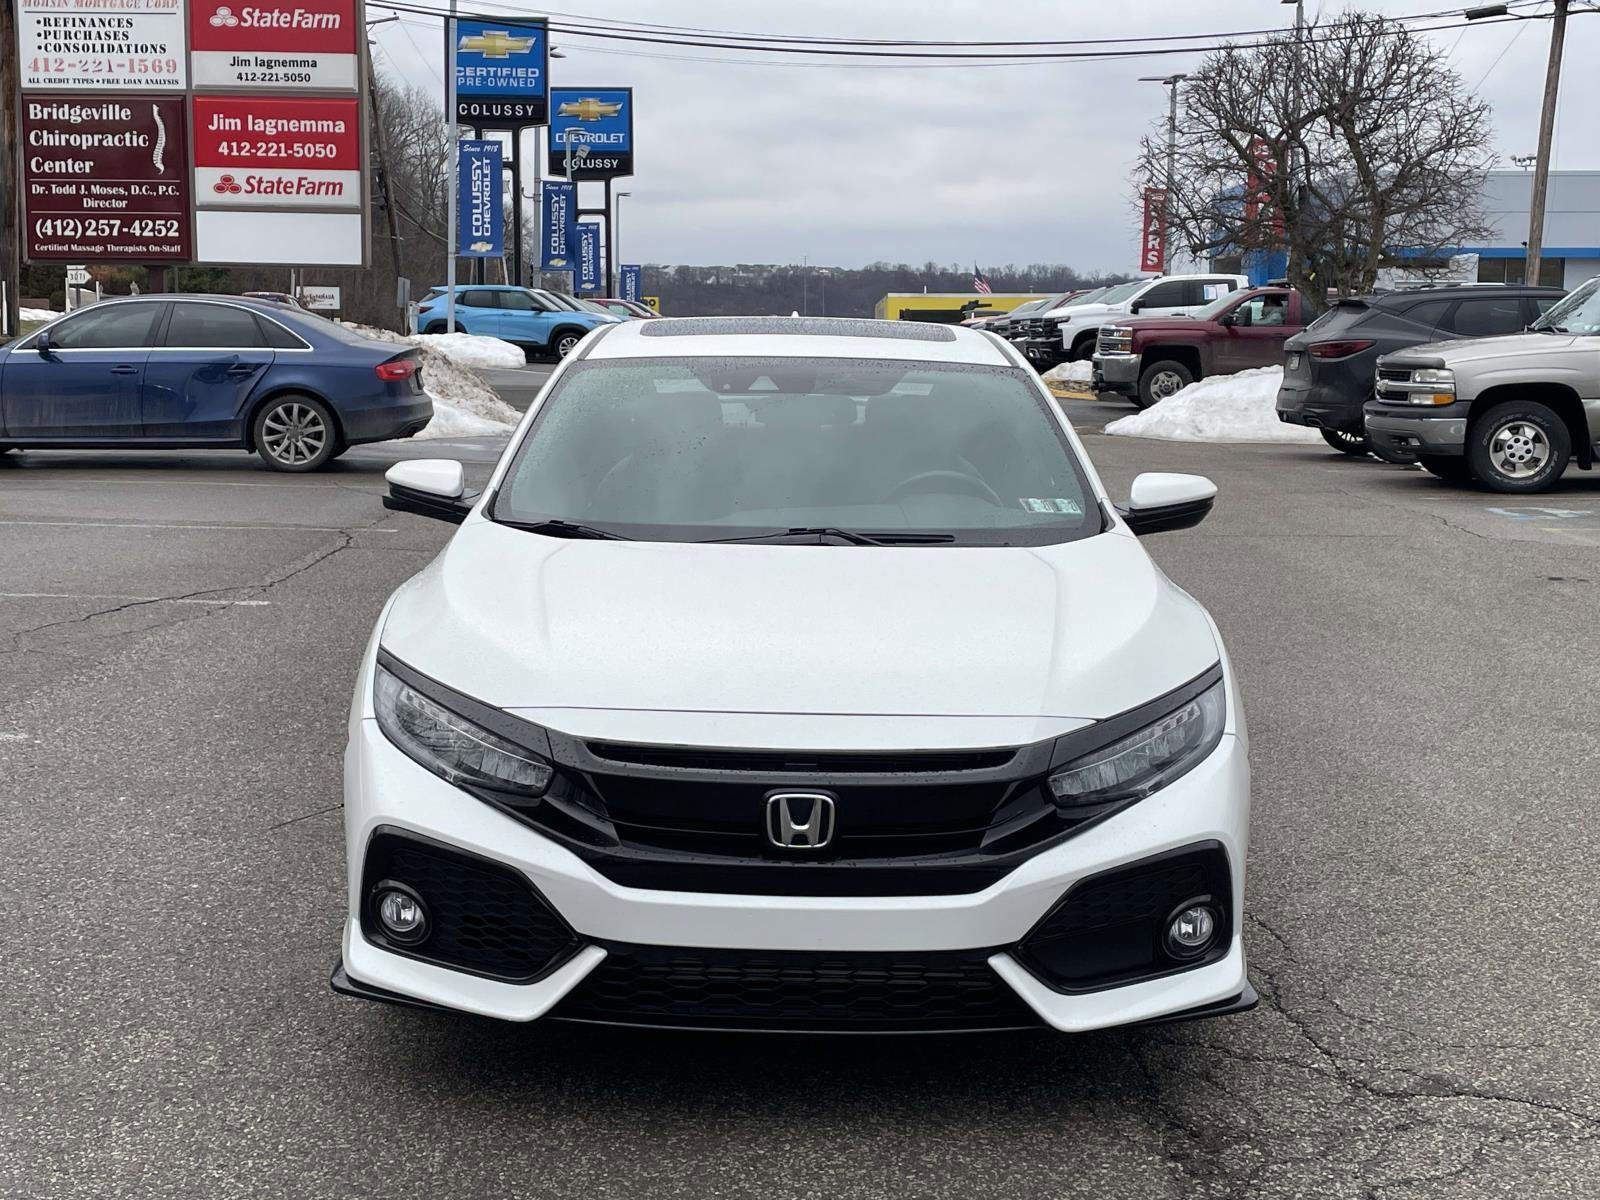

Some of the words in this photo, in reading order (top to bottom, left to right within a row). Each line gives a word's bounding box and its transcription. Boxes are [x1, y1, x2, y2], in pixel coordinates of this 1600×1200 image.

[43, 17, 134, 29] REFINANCES
[43, 30, 130, 41] PURCHASES
[44, 43, 167, 54] CONSOLIDATIONS
[28, 57, 178, 74] 412-221-1569
[229, 56, 251, 68] Jim
[255, 56, 318, 70] Iagnemma
[237, 72, 311, 83] 412-221-5050
[456, 66, 540, 78] CERTIFIED
[458, 77, 536, 88] PRE-OWNED
[29, 103, 132, 124] Bridgeville
[459, 103, 535, 116] COLUSSY
[208, 114, 241, 131] Jim
[247, 115, 346, 136] Iagnemma
[29, 130, 149, 150] Chiropractic
[218, 141, 337, 159] 412-221-5050
[30, 156, 94, 173] Center
[31, 184, 48, 195] Dr.
[51, 184, 76, 195] Todd
[79, 185, 88, 195] J.
[91, 185, 128, 196] Moses,
[131, 185, 157, 196] D.C.,
[158, 186, 180, 196] P.C.
[472, 157, 482, 237] COLUSSY
[483, 157, 491, 237] CHEVROLET
[83, 198, 128, 208] Director
[35, 218, 83, 239] (412)
[85, 219, 179, 237] 257-4252
[551, 193, 559, 255] COLUSSY
[34, 243, 69, 252] Certified
[71, 244, 104, 253] Massage
[107, 244, 147, 253] Therapists
[149, 245, 181, 253] On-Staff
